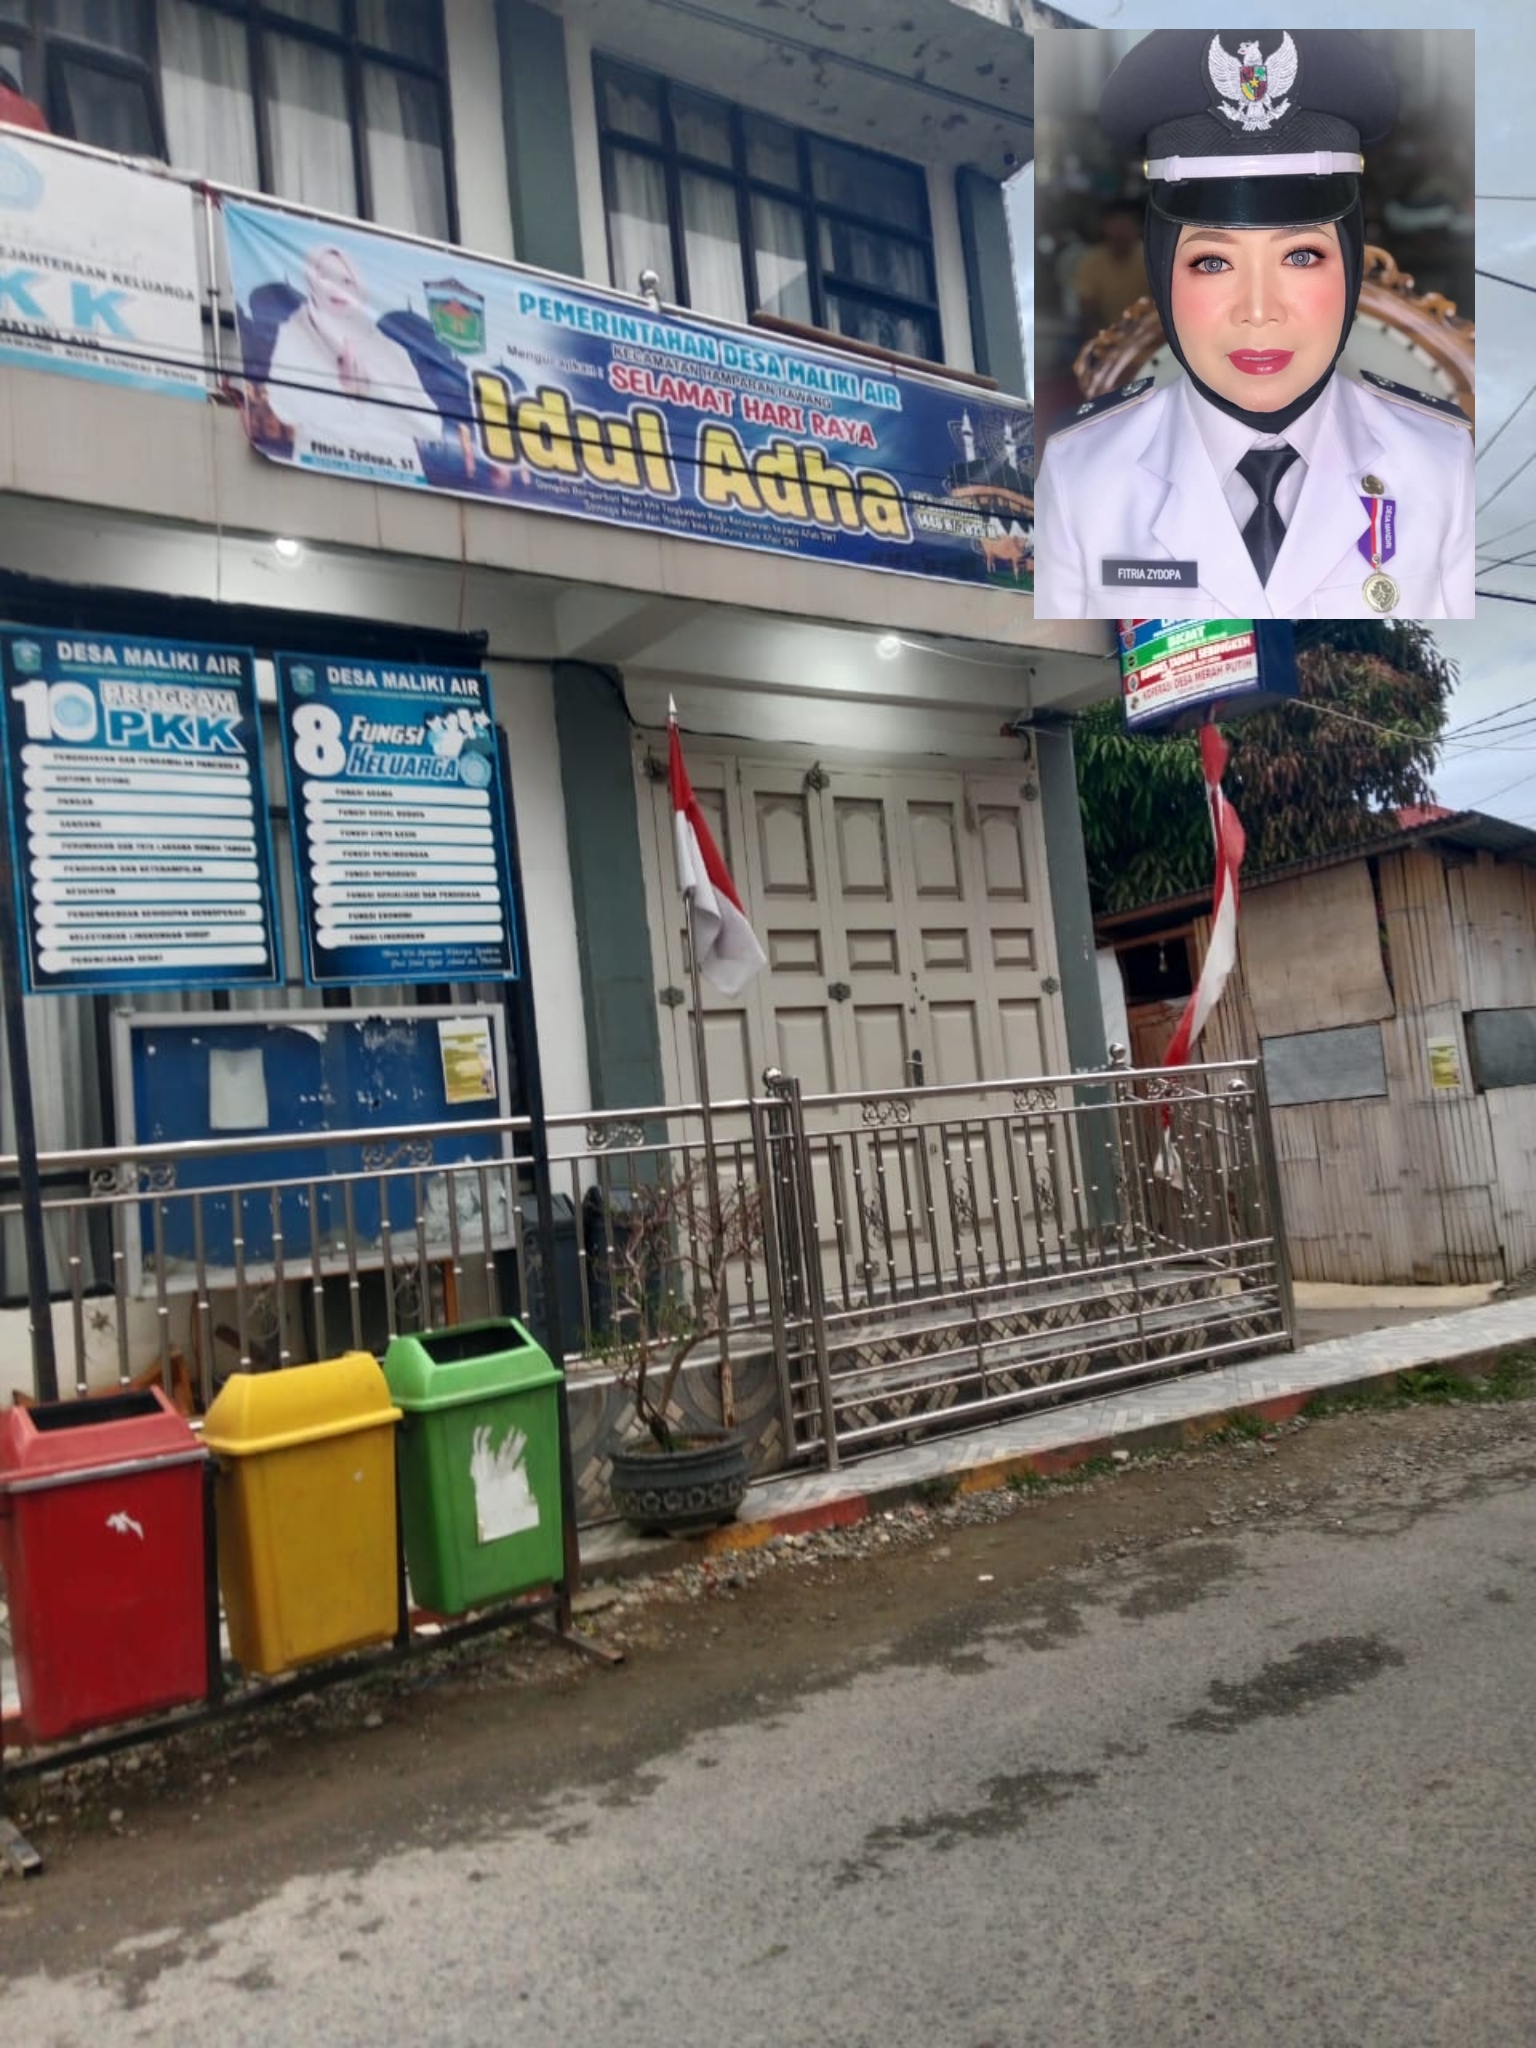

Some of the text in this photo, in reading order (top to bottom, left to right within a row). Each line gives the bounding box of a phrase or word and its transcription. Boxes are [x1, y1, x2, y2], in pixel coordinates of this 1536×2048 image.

[517, 290, 902, 412] PEMERINTAHAN DESA MALIKI AIR
[608, 361, 877, 449] SELAMAT HARI RAYA
[471, 367, 915, 545] Idul Adha
[57, 640, 117, 666] DESA
[124, 647, 199, 672] MALIKI
[205, 653, 242, 676] AIR
[327, 666, 378, 687] DESA
[382, 671, 445, 693] MALIKI
[450, 678, 480, 697] AIR
[10, 679, 98, 743] 10
[104, 706, 246, 754] PKK
[292, 703, 346, 777] 8
